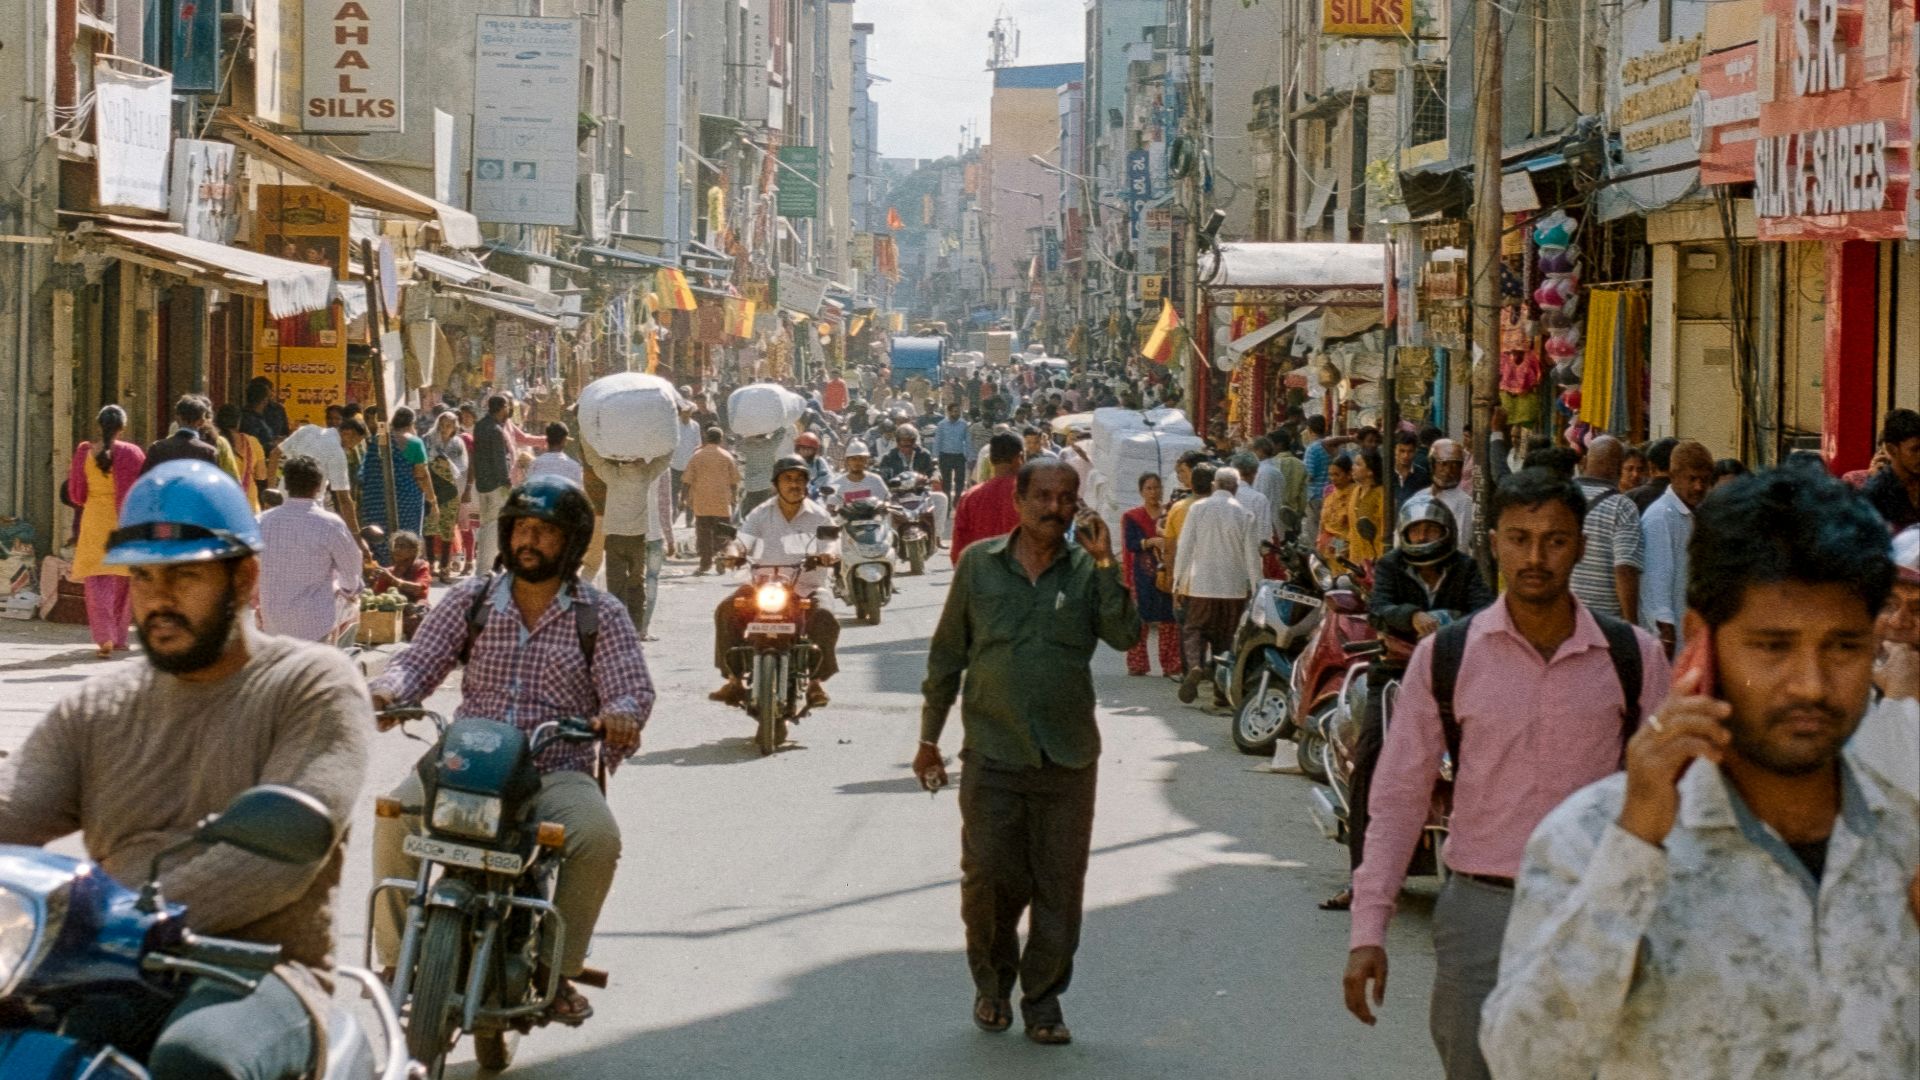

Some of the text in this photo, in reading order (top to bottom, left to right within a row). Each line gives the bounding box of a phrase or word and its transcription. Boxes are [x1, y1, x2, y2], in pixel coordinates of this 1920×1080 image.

[1331, 0, 1404, 24] SILKS
[308, 98, 396, 118] SILKS
[1755, 134, 1790, 217] SILK
[1813, 121, 1886, 215] SAREES
